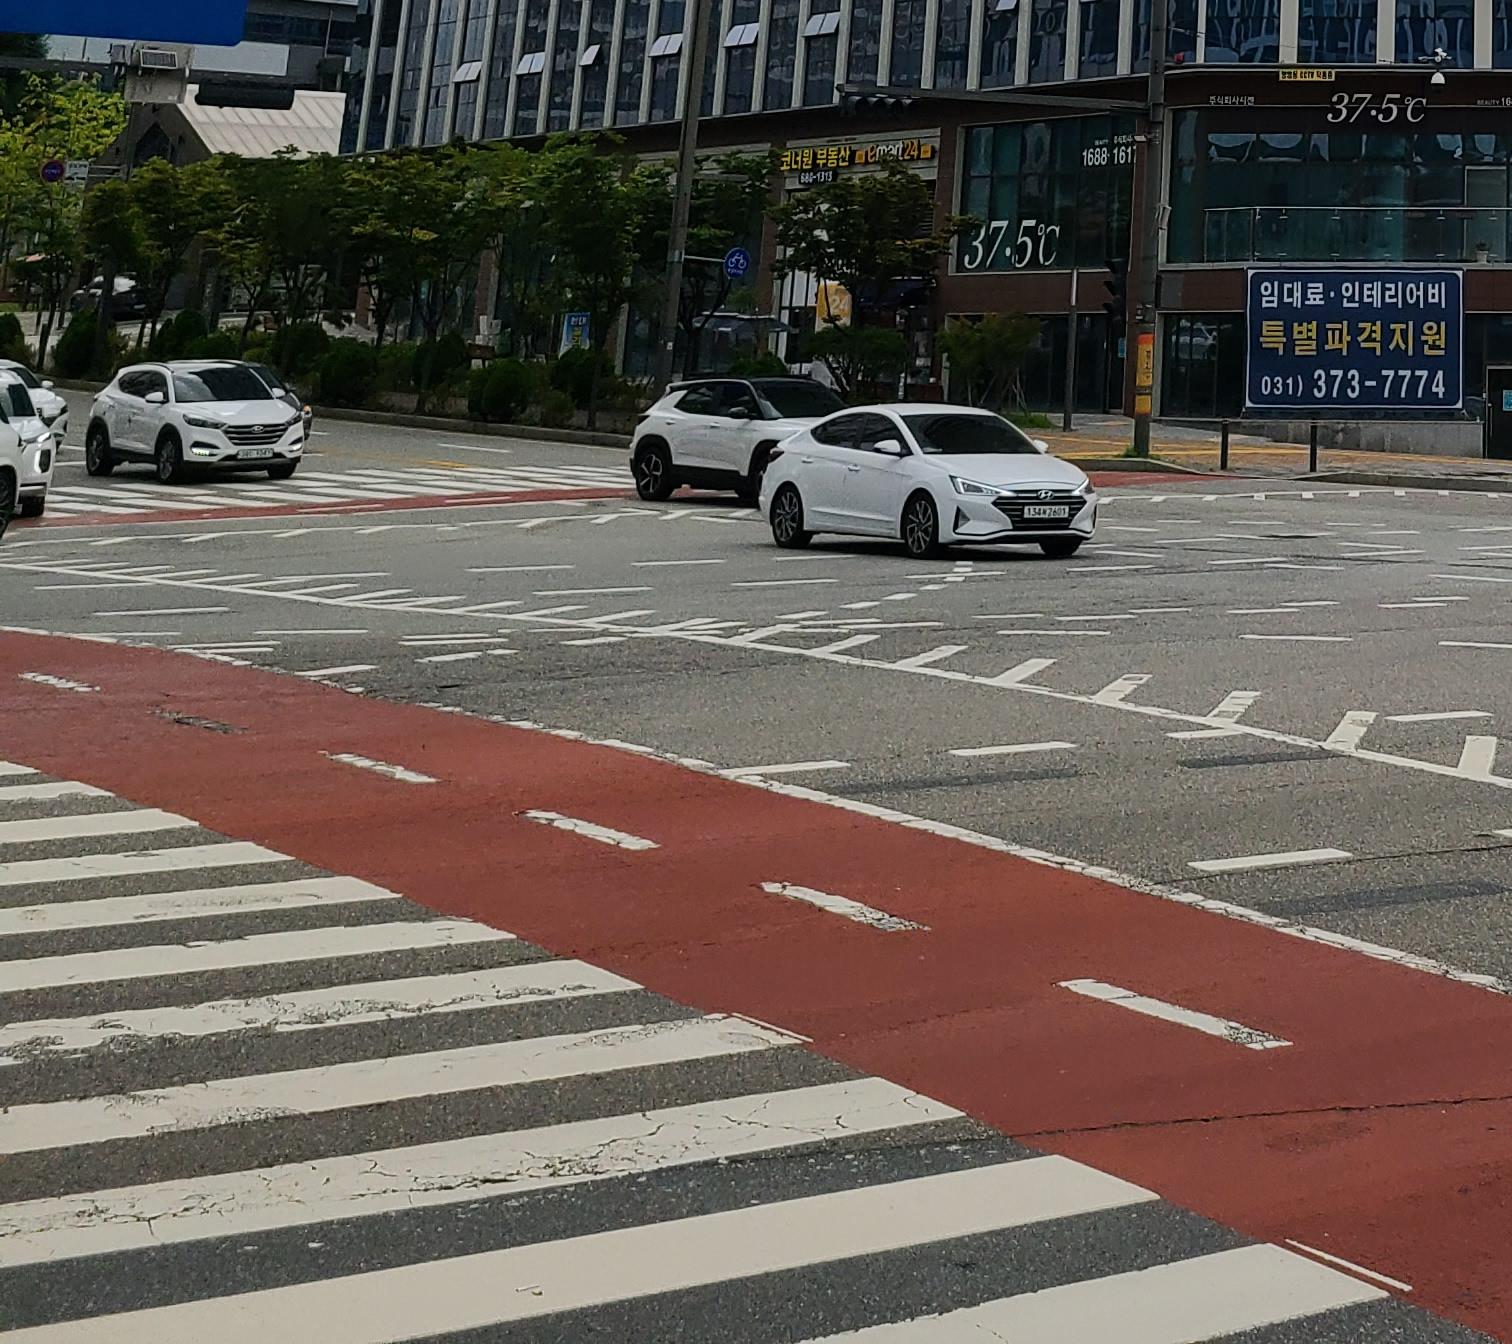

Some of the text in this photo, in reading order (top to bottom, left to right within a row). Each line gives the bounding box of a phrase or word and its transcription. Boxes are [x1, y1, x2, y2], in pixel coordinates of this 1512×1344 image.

[780, 145, 850, 170] 코너원 부동산
[1259, 320, 1446, 356] 특별파격지원
[1261, 369, 1446, 399] 031) 373-7774
